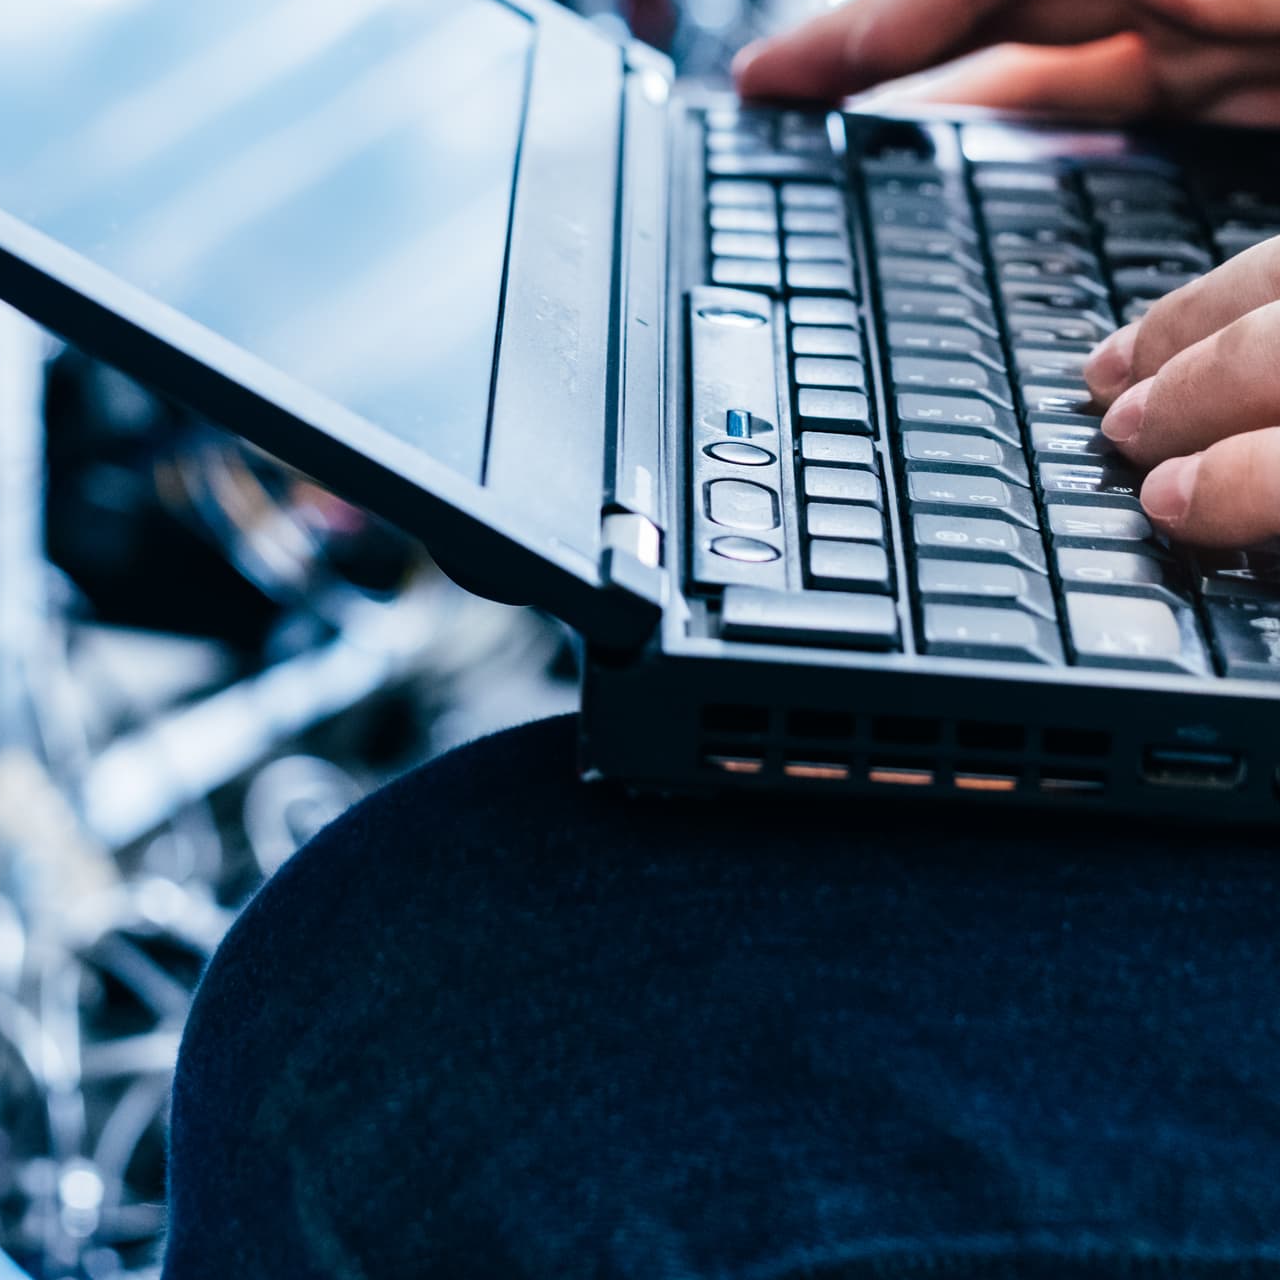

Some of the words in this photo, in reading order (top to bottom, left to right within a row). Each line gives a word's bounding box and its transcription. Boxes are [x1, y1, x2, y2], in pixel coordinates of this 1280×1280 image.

[954, 414, 982, 422] 5
[962, 453, 991, 461] 4
[1056, 481, 1093, 491] E
[1063, 519, 1103, 534] W
[975, 537, 1006, 547] 2
[1216, 568, 1256, 580] A
